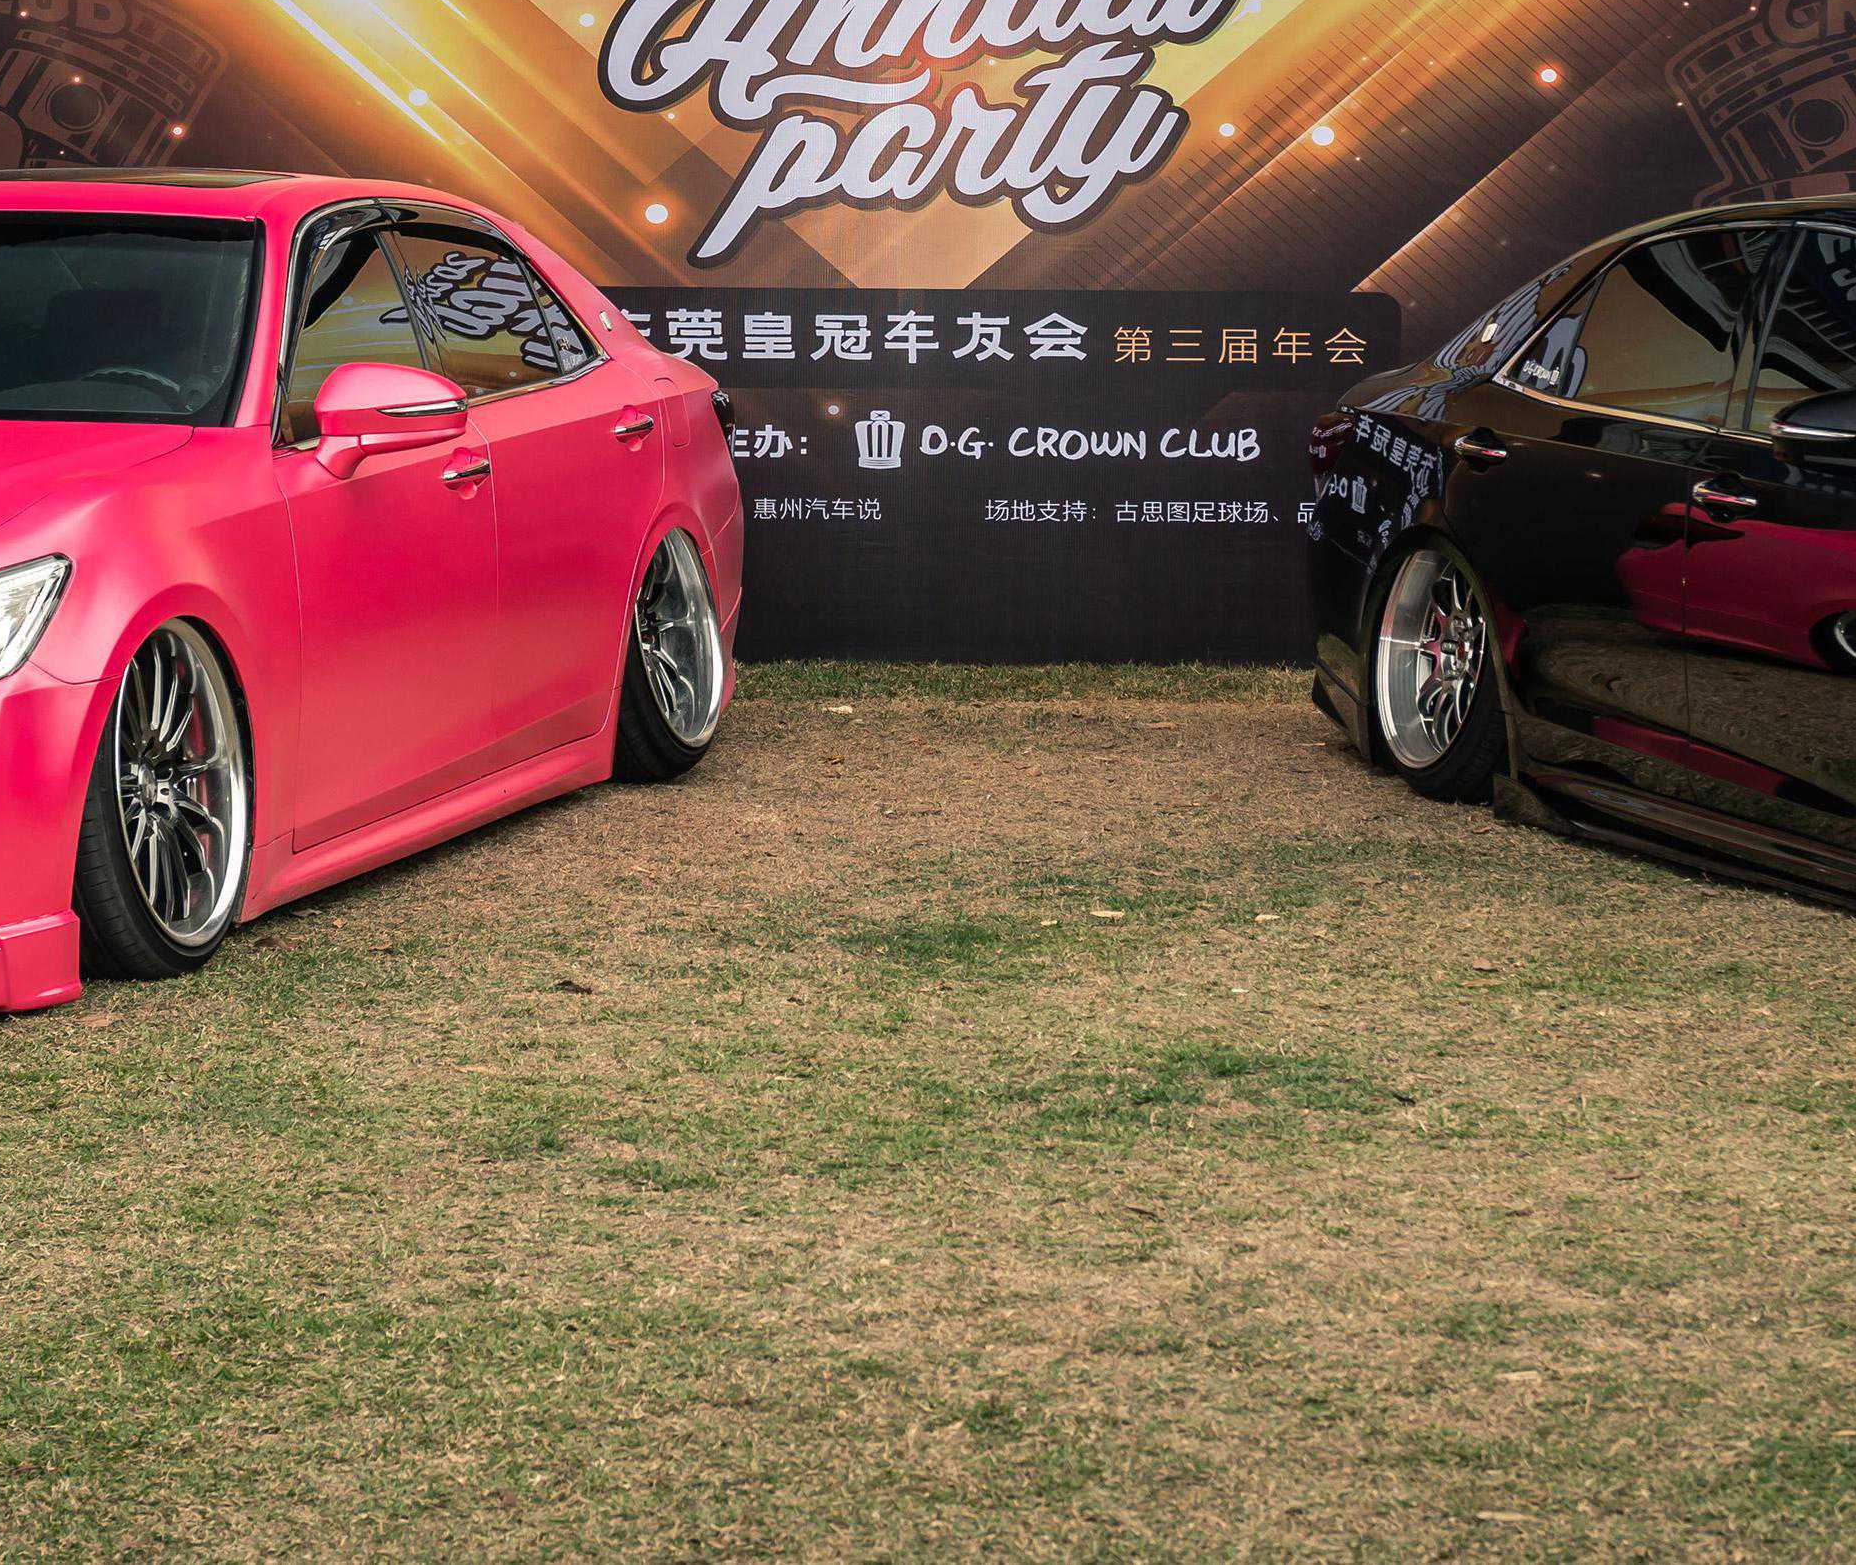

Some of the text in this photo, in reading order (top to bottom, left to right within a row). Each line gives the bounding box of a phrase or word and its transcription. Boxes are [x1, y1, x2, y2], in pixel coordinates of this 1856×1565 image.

[692, 41, 1183, 263] party
[1112, 325, 1369, 367] 第三届年会
[1007, 426, 1148, 461] CROWN
[1159, 427, 1262, 462] CLUB
[753, 497, 883, 522] 惠州汽车说
